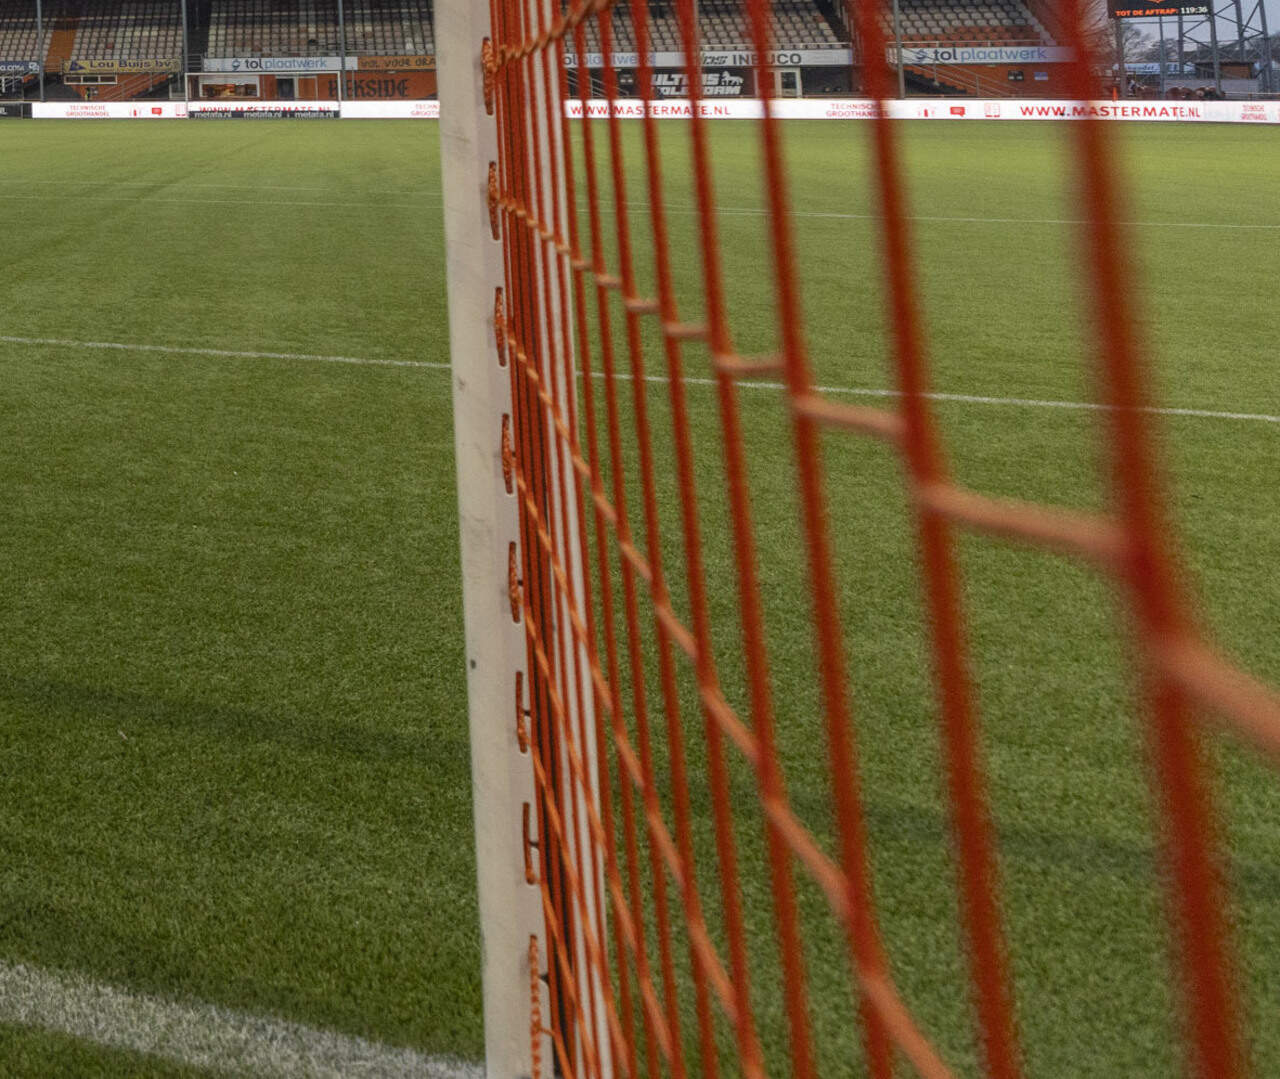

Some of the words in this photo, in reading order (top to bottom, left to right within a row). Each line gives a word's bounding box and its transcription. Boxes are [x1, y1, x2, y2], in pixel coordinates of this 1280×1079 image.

[934, 49, 958, 61] tol
[961, 46, 1048, 62] plaatwerk
[244, 58, 263, 69] tol
